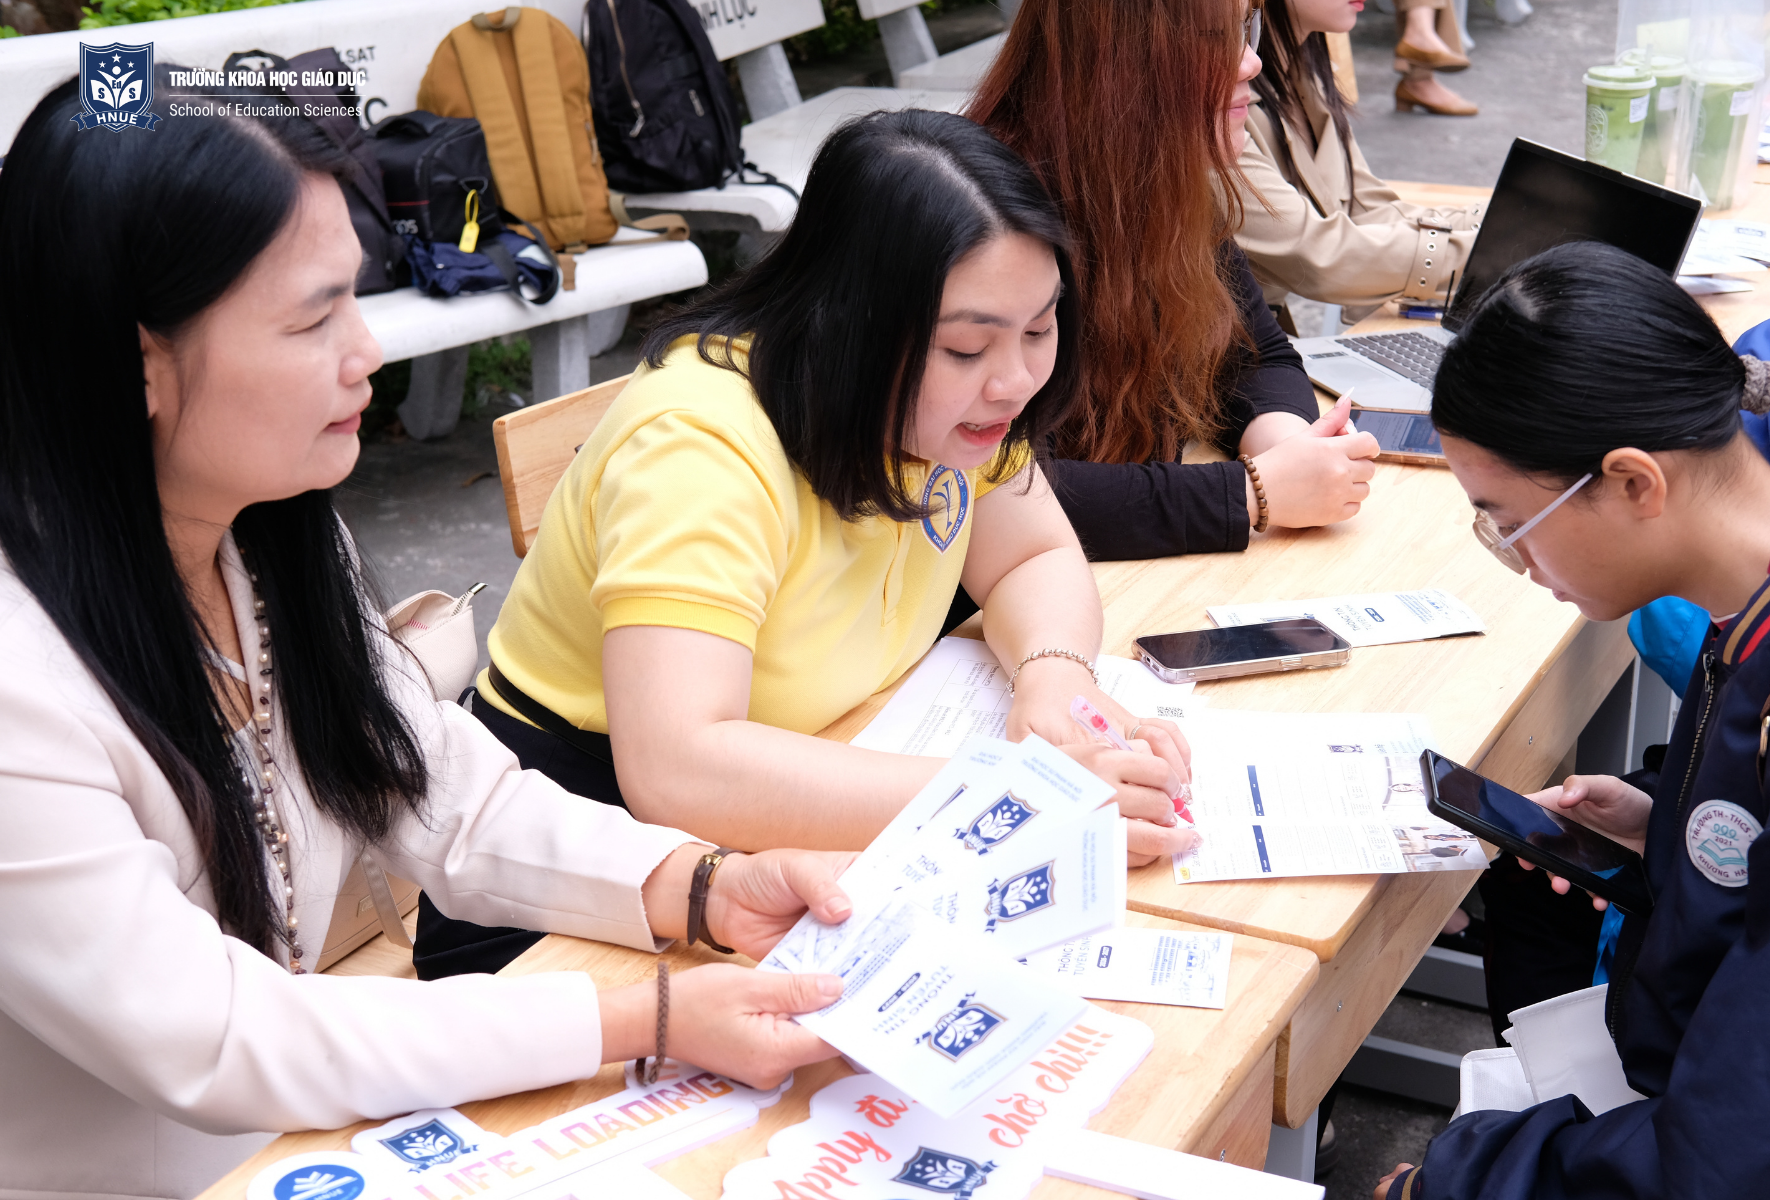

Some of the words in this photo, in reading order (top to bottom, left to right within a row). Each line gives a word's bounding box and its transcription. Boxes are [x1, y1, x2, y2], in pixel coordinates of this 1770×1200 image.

[1730, 814, 1752, 834] THCS
[1714, 835, 1733, 846] 2021
[531, 1072, 734, 1161] LOADING
